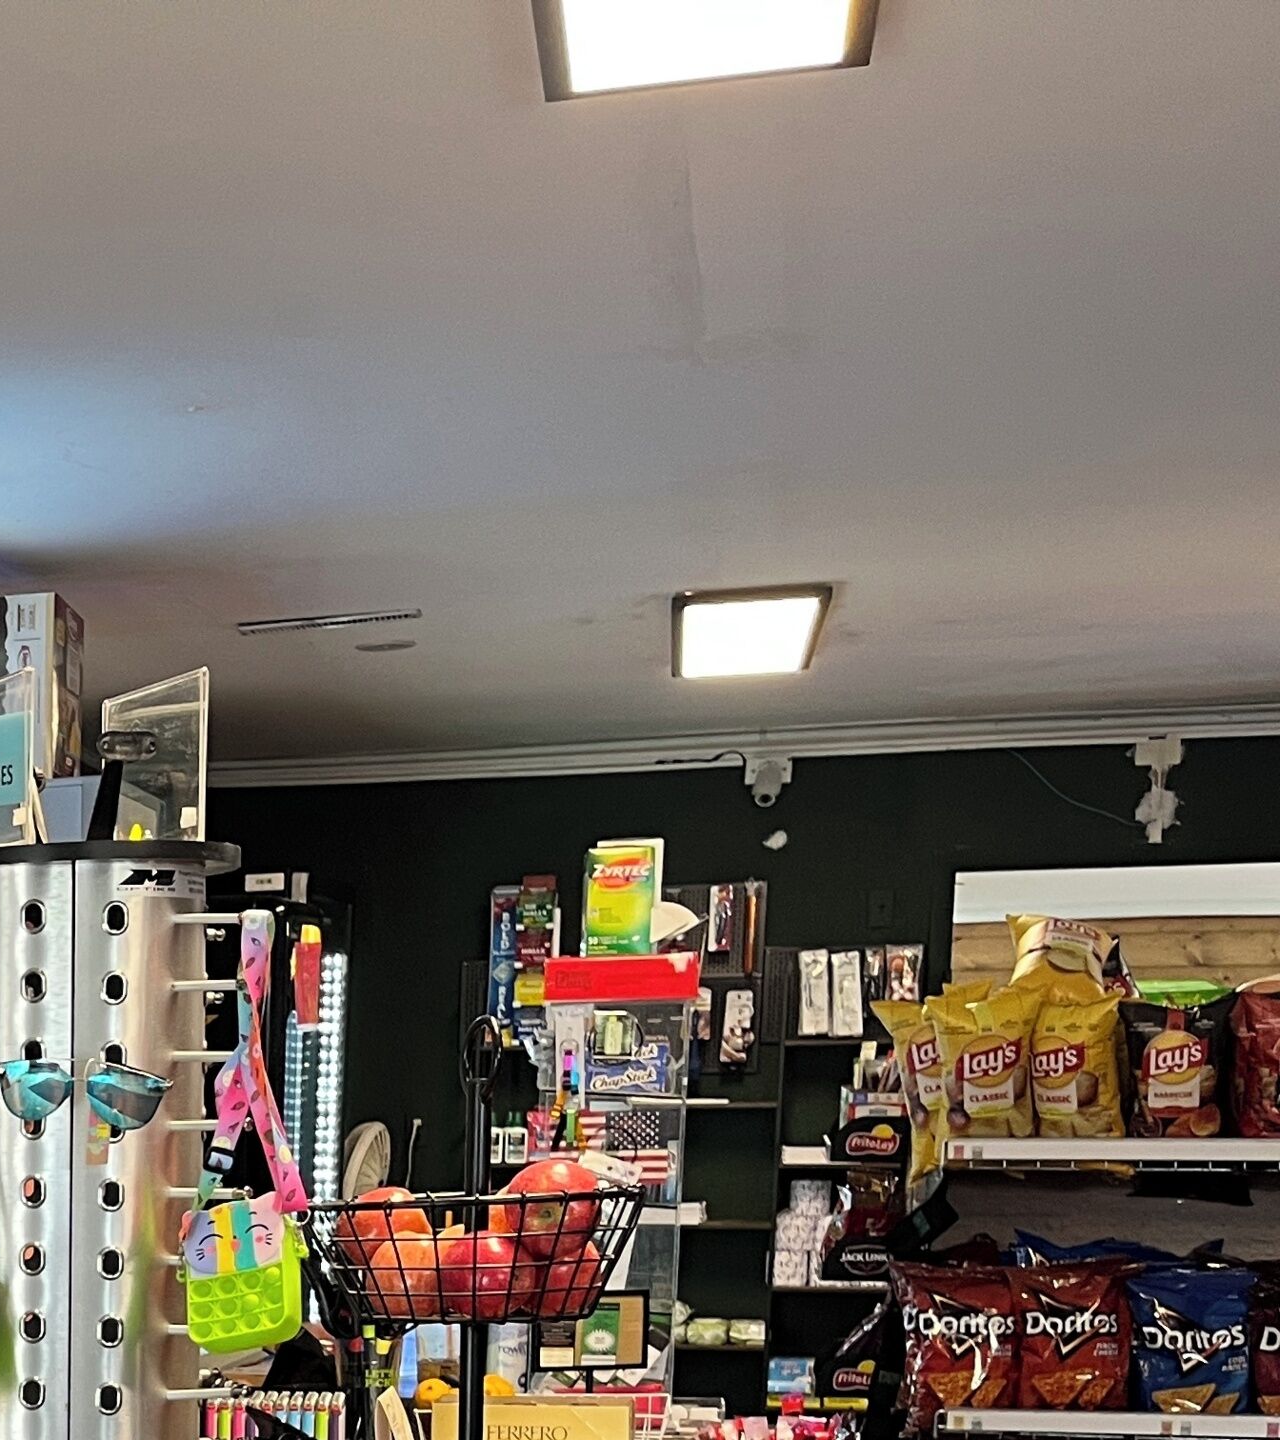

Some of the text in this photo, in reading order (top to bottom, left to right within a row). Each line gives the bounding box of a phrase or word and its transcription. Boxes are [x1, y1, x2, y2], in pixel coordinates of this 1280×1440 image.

[592, 864, 651, 879] ZYRTEC
[964, 1043, 1021, 1078] Lay's
[1150, 1042, 1202, 1074] Lay's
[592, 1068, 657, 1090] ChapStick
[969, 1091, 1009, 1103] CLASSIC
[840, 1253, 864, 1262] JACK
[920, 1309, 1015, 1337] Doritos
[1025, 1310, 1117, 1336] Doritos
[1144, 1324, 1244, 1351] Doritos
[486, 1425, 567, 1440] FERRERO
